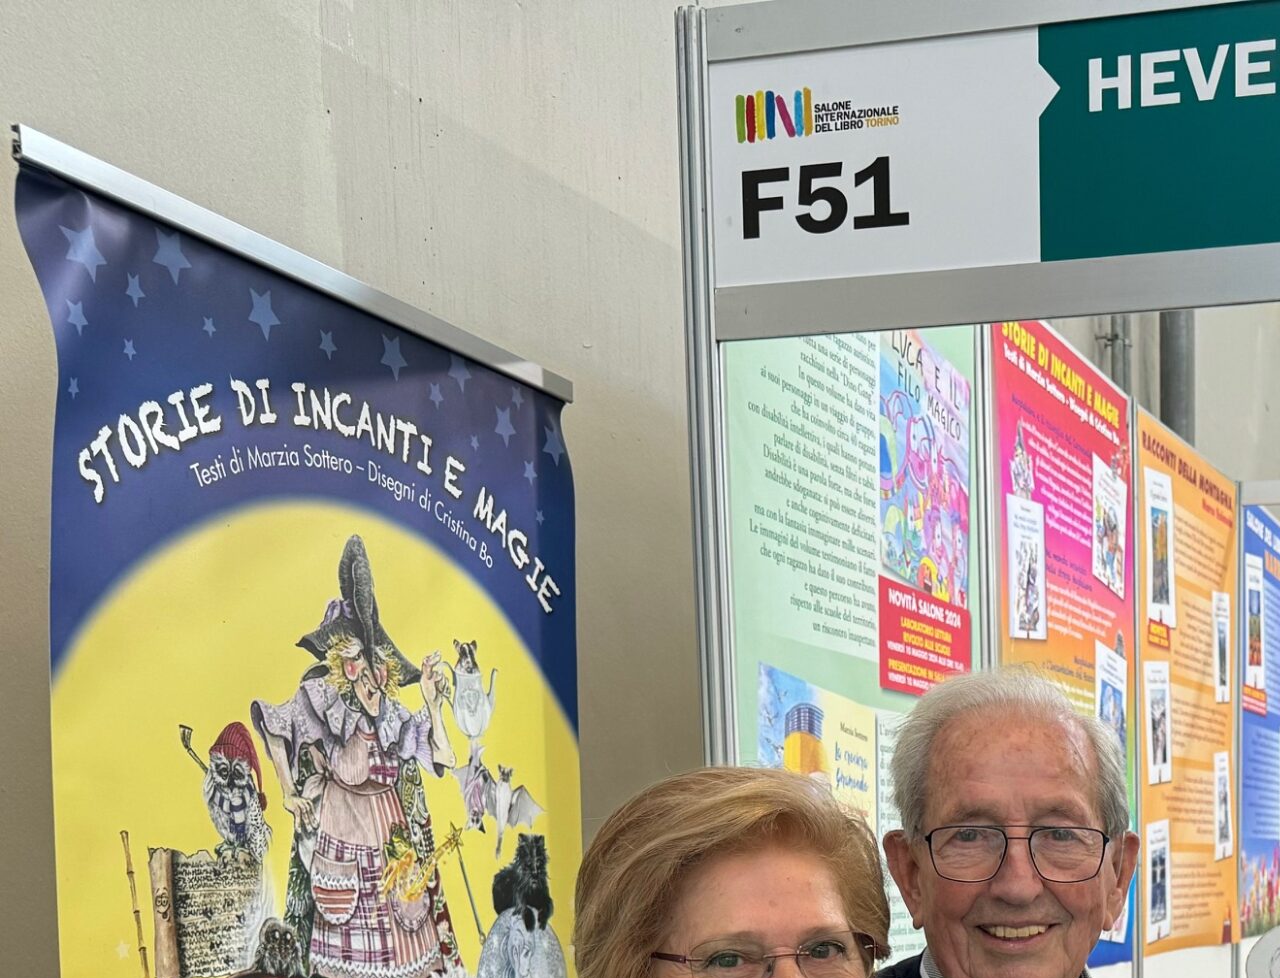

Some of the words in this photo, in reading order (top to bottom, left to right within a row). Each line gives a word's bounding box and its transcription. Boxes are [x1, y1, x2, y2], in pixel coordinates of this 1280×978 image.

[815, 100, 851, 113] SALONE
[815, 106, 898, 123] INTERNAZIONALE
[815, 123, 832, 133] DEL
[835, 120, 863, 131] LIBRO
[865, 116, 899, 128] TORINO
[742, 156, 909, 239] F51
[892, 330, 923, 368] LUCA
[935, 359, 941, 394] E
[950, 375, 960, 409] IL
[898, 361, 921, 403] FILO
[928, 394, 961, 441] MAGICO
[1002, 322, 1035, 358] STORIE
[1038, 343, 1048, 369] DI
[1051, 355, 1084, 397] INCANTI
[1087, 385, 1092, 405] E
[1094, 392, 1118, 427] MAGIE
[1004, 343, 1017, 364] Testi
[1026, 362, 1045, 386] Marzia
[1046, 378, 1064, 402] Sottero
[79, 382, 221, 503] STORIE
[230, 374, 277, 426] DI
[292, 382, 432, 475] INCANTI
[444, 456, 465, 499] E
[473, 487, 561, 613] MAGIE
[190, 460, 224, 487] Testi
[230, 446, 244, 473] di
[248, 444, 300, 469] Marzia
[303, 444, 353, 474] Sottero
[368, 461, 415, 501] Disegni
[419, 488, 431, 512] di
[435, 501, 477, 551] Cristina
[480, 542, 493, 568] Bo
[1142, 432, 1175, 468] RACCONTI
[1178, 458, 1196, 484] DELLA
[1199, 475, 1231, 509] MONTAGNA
[888, 589, 916, 611] NOVITÀ
[918, 600, 943, 621] SALONE
[945, 610, 960, 627] 2024
